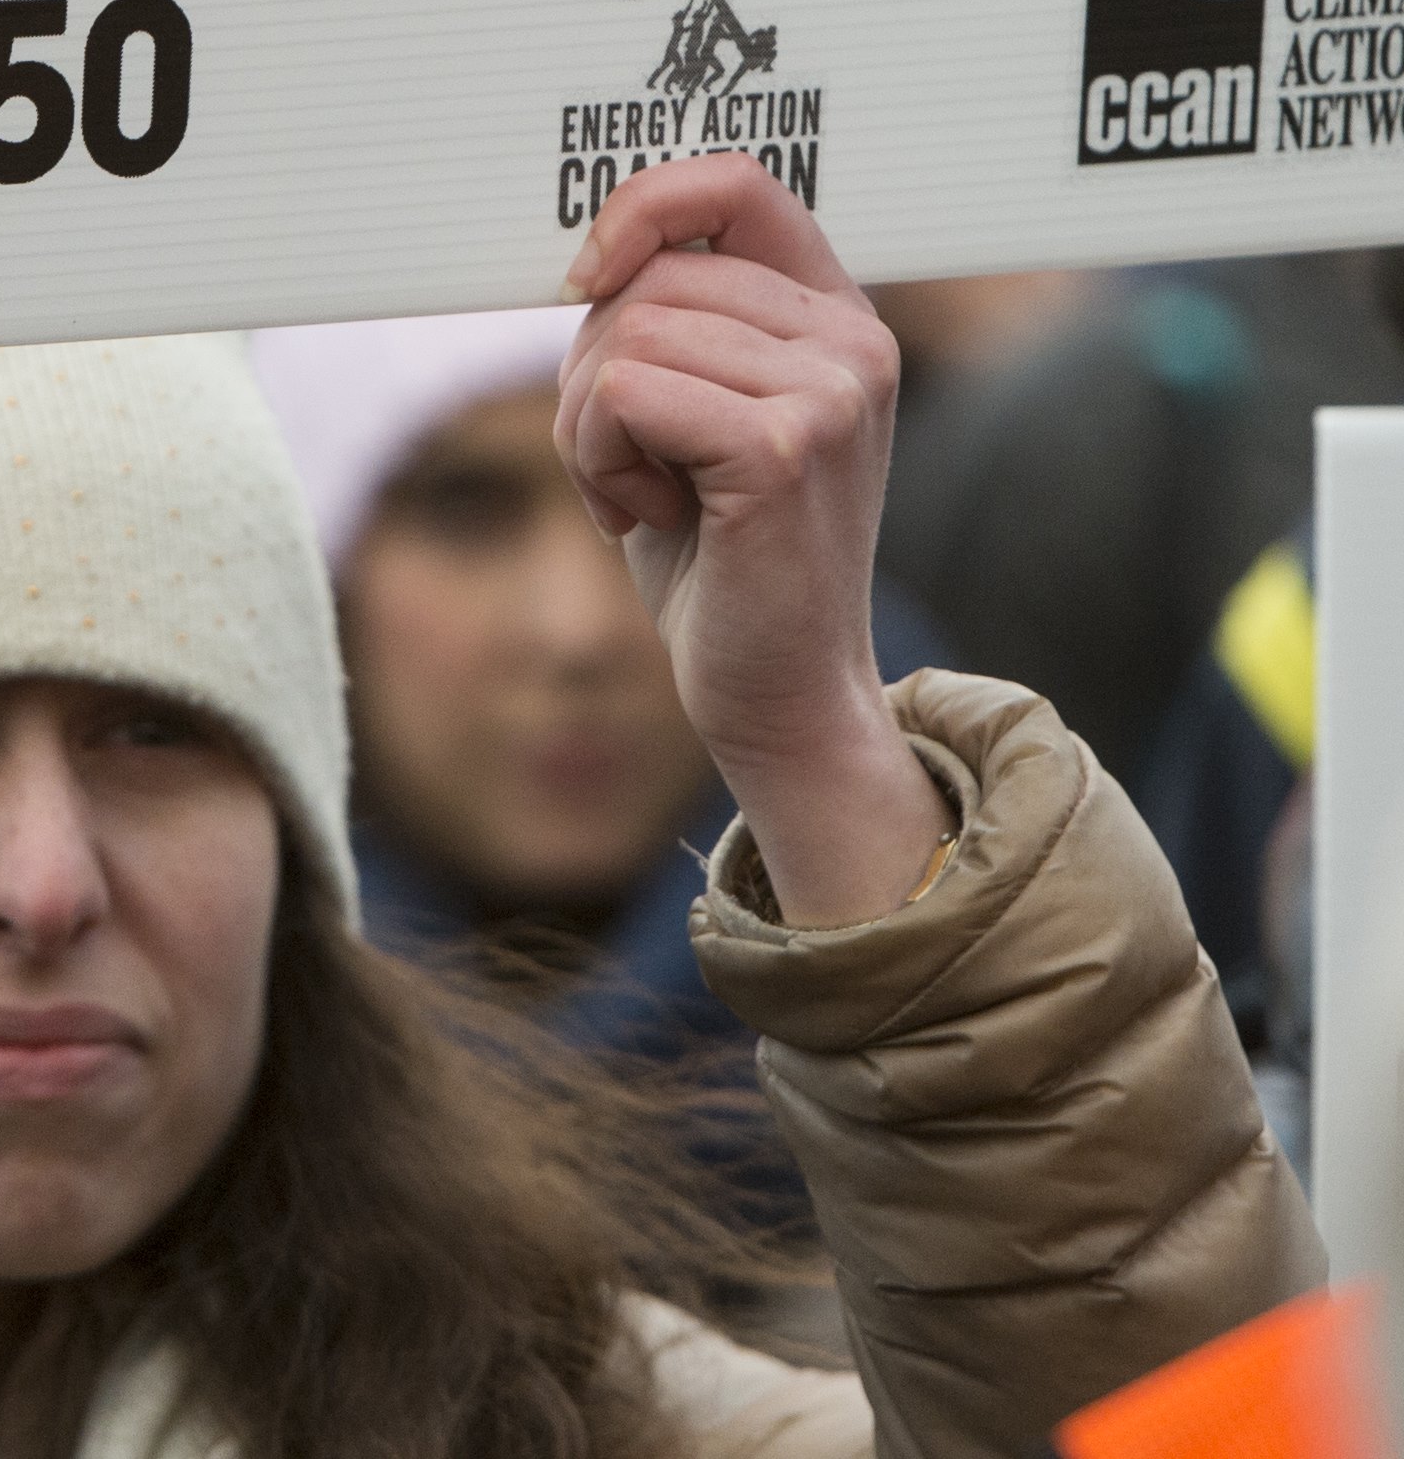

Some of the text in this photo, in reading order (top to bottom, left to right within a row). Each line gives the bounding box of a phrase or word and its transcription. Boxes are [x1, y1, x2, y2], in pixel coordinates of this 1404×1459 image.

[561, 88, 821, 153] ENERGY ACTION
[1085, 65, 1254, 153] ccan
